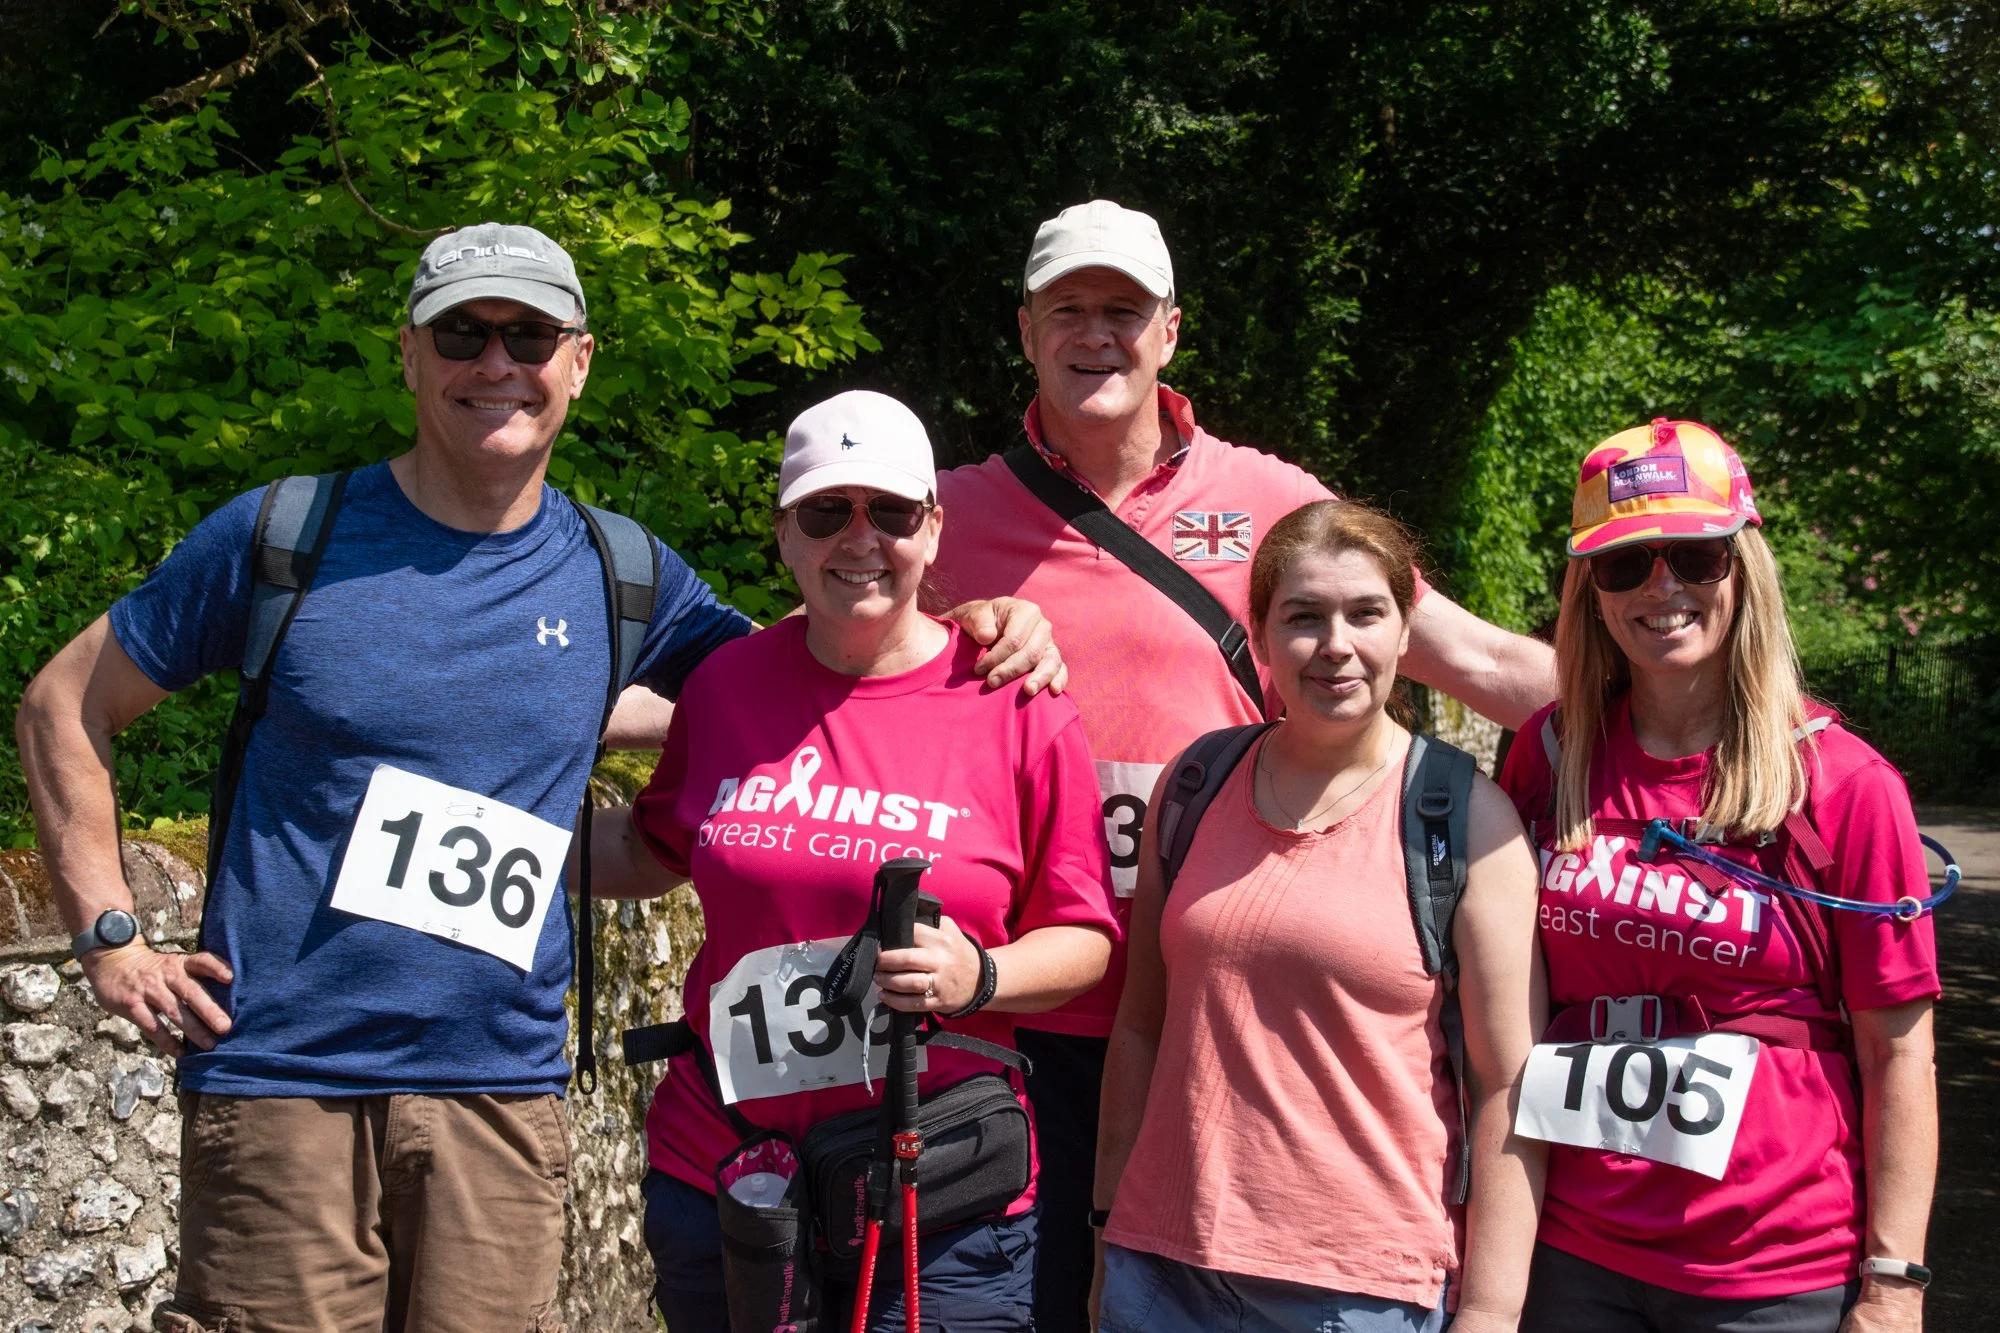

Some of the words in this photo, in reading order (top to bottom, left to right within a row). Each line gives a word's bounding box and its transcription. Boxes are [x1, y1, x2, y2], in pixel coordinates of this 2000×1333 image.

[1614, 463, 1657, 480] LONDON
[699, 819, 796, 851] breast
[1431, 834, 1439, 866] TRESPASS
[380, 810, 542, 928] 136
[1614, 918, 1757, 968] cancer
[1554, 1044, 1733, 1136] 105
[864, 1255, 876, 1308] MOUNTAIN
